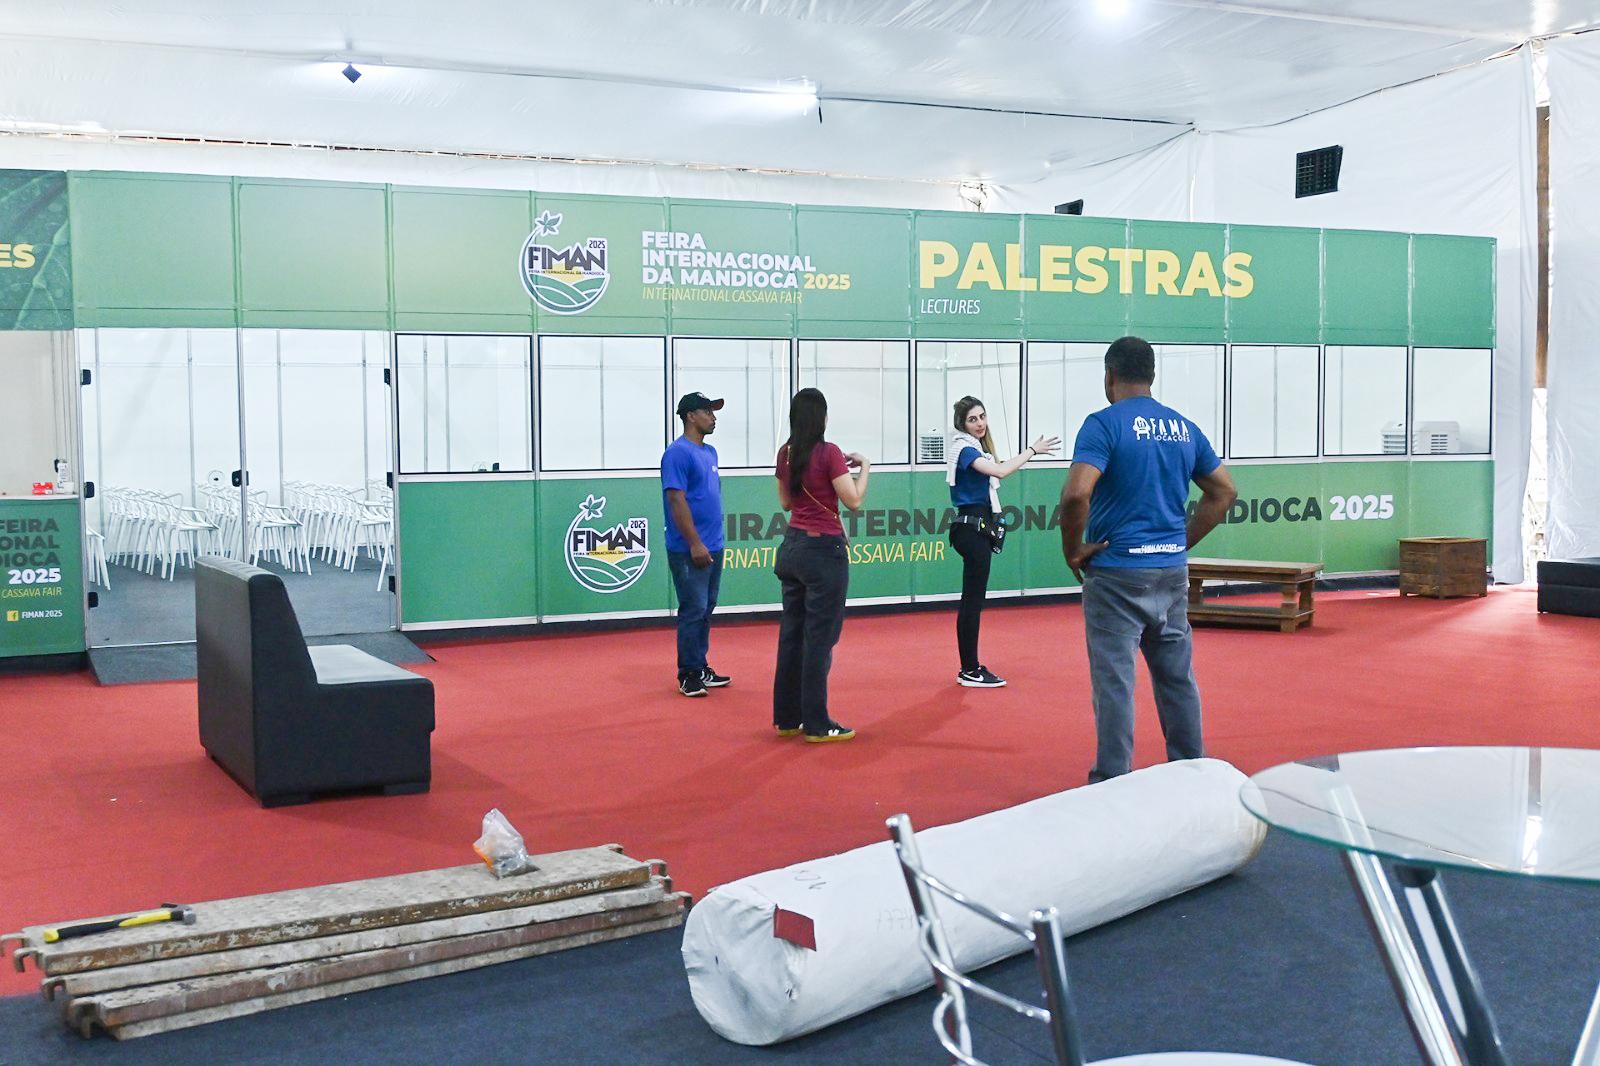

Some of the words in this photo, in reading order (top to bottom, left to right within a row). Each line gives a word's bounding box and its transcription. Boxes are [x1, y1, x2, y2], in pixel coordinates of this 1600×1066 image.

[588, 240, 606, 249] 2025
[642, 231, 707, 249] FEIRA
[528, 246, 605, 271] FIMAN
[642, 249, 816, 272] INTERNACIONAL
[919, 240, 1254, 298] PALESTRAS
[642, 267, 674, 285] DA
[681, 269, 798, 289] MANDIOCA
[803, 273, 851, 290] 2025
[642, 287, 730, 302] INTERNATIONAL
[732, 289, 778, 304] CASSAVA
[780, 291, 803, 304] FAIR
[920, 298, 980, 314] LECTURES
[1149, 418, 1188, 436] FAMA
[1329, 495, 1395, 521] 2025
[630, 520, 646, 529] 2025
[573, 527, 646, 551] FIMAN
[0, 552, 61, 568] IOCA
[909, 541, 945, 562] FAIR
[8, 568, 61, 585] 2025
[1, 588, 41, 598] CASSAVA
[42, 587, 62, 597] FAIR
[21, 610, 44, 619] FIMAN
[45, 610, 62, 618] 2025
